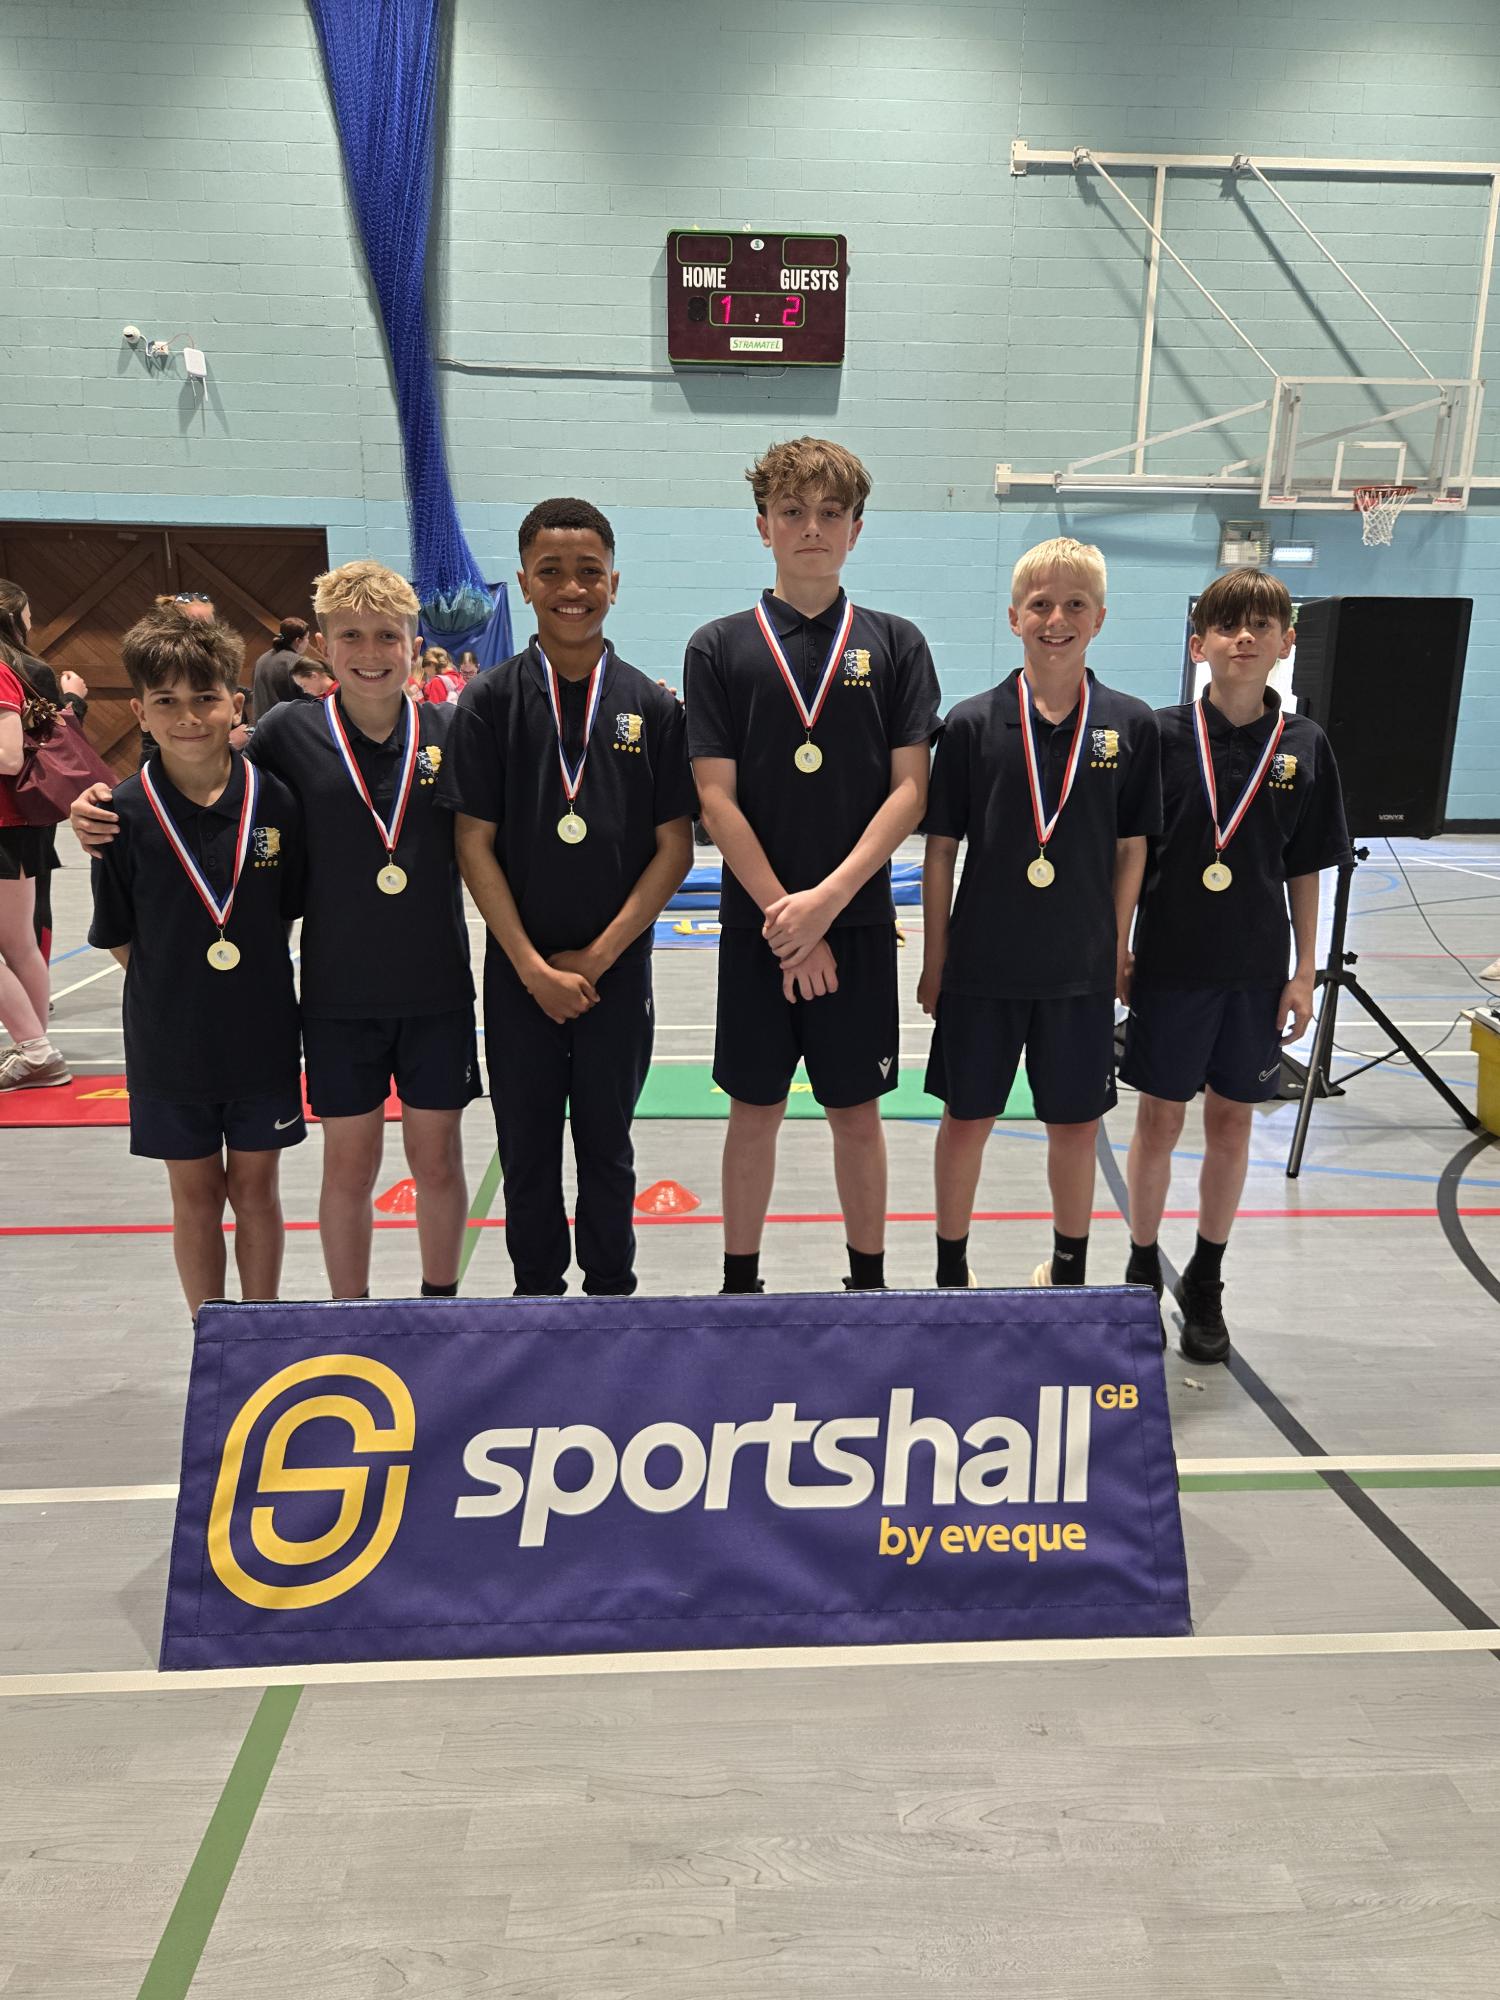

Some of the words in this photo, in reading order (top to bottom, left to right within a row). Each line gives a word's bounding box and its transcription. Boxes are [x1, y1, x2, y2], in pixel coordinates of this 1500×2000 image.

[682, 266, 727, 288] HOME
[780, 268, 839, 291] GUESTS
[719, 295, 732, 324] 1
[781, 296, 801, 326] 2
[454, 1385, 1092, 1547] sportshall
[1095, 1383, 1139, 1410] GB
[878, 1517, 933, 1565] by
[939, 1522, 1087, 1564] eveque
